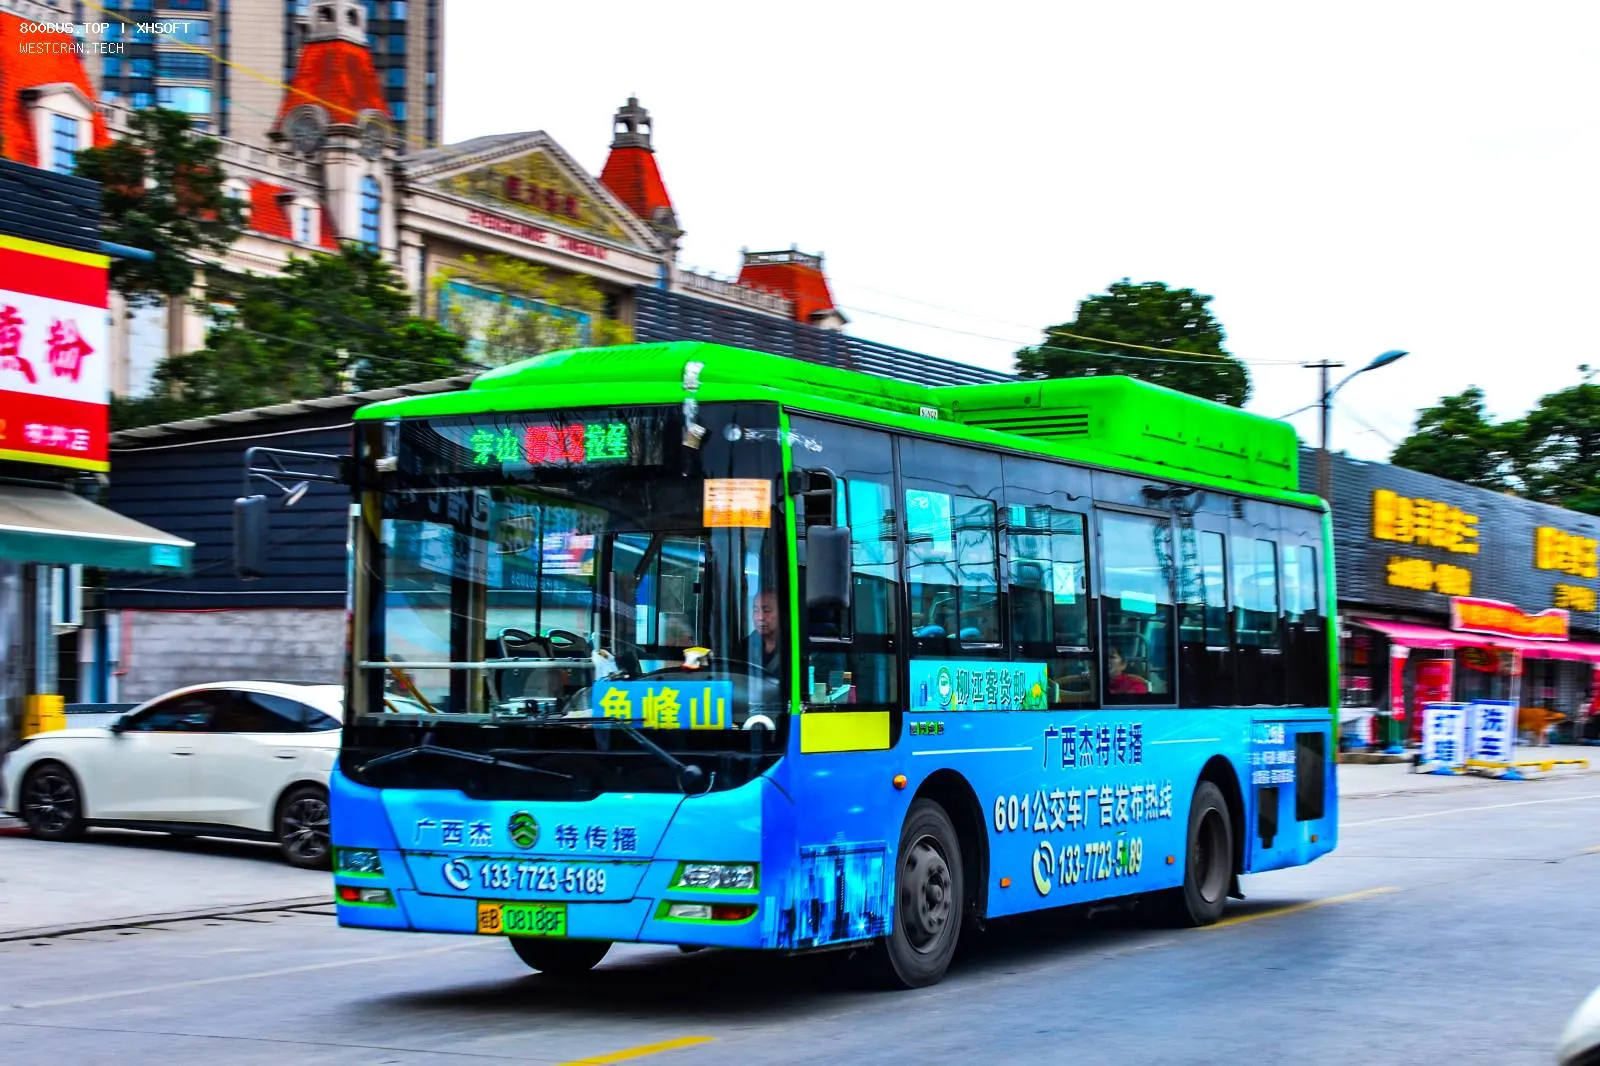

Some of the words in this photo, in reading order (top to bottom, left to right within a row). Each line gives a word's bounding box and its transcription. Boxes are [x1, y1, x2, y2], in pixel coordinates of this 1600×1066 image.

[955, 667, 1026, 705] 柳江客货邮
[1042, 722, 1143, 770] 广西杰特传播
[993, 780, 1173, 833] 601公交车广告发布热线
[414, 817, 493, 848] 广西杰
[555, 823, 638, 853] 特传播
[480, 862, 608, 894] 133-7723-5189
